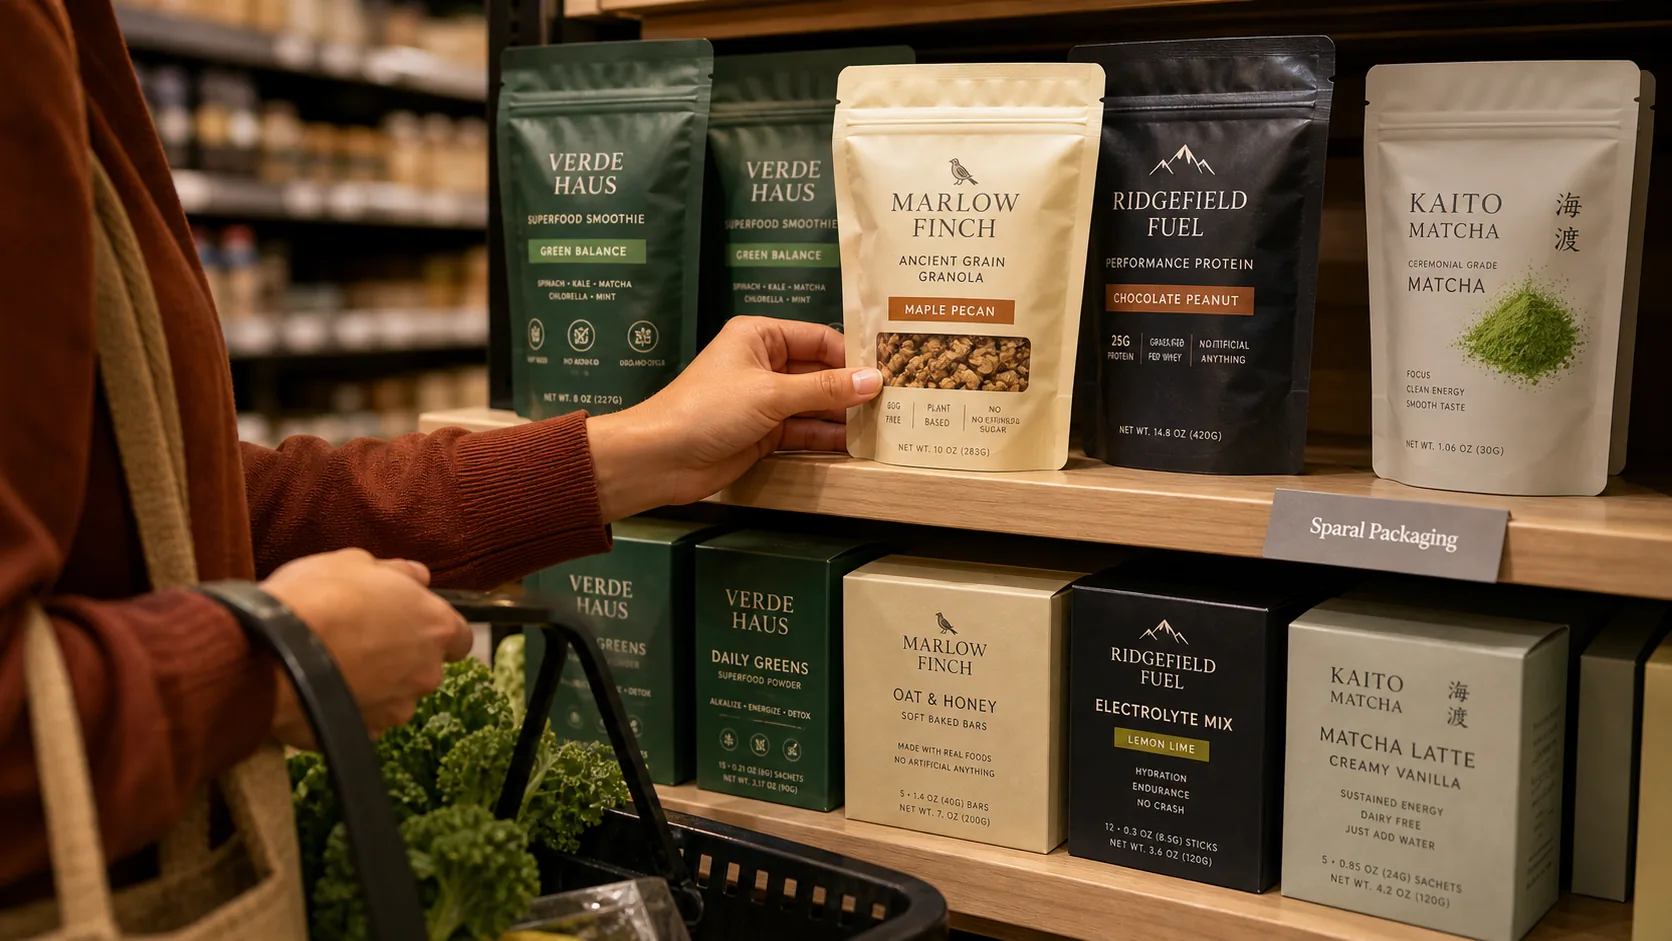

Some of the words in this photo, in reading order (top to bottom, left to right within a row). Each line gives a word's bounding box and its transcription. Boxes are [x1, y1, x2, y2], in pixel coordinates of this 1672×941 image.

[548, 152, 624, 172] VERDE
[746, 160, 822, 179] VERDE
[554, 175, 617, 195] HAUS
[751, 182, 815, 202] HAUS
[890, 192, 1020, 213] MARLOW
[1113, 190, 1248, 211] RIDGEFIELD
[1409, 192, 1503, 215] KAITO
[527, 213, 583, 225] SUPERFOOD
[586, 213, 645, 224] SMOOTHIE
[724, 218, 780, 230] SUPERFOOD
[782, 218, 837, 229] SMOOTHIE
[912, 218, 996, 238] FINCH
[1147, 217, 1204, 237] FUEL
[1554, 192, 1582, 252] 海渡
[1408, 222, 1500, 240] MATCHA
[540, 245, 572, 257] GREEN
[575, 245, 627, 257] BALANCE
[736, 249, 768, 261] GREEN
[771, 249, 821, 261] BALANCE
[898, 255, 958, 267] ANCIENT
[962, 255, 1005, 268] GRAIN
[1105, 257, 1190, 269] PERFORMANCE
[1195, 257, 1254, 270] PROTEIN
[1407, 259, 1464, 269] CEREMONIAL
[1466, 260, 1498, 270] GRADE
[537, 279, 566, 288] SPINACH
[572, 279, 591, 288] KALE
[598, 280, 633, 288] MATCHA
[918, 270, 984, 284] GRANOLA
[1408, 276, 1486, 294] MATCHA
[548, 292, 589, 301] CHLORELLA
[595, 292, 616, 301] MINT
[1113, 292, 1181, 305] CHOCOLATE
[1186, 293, 1239, 306] PEANUT
[904, 304, 946, 316] MAPLE
[951, 304, 995, 317] PECAN
[1111, 334, 1131, 347] 25G
[1107, 351, 1135, 361] PROTEIN
[1200, 354, 1246, 365] ANYTHING
[1406, 369, 1431, 380] FOCUS
[543, 392, 557, 402] NET
[558, 393, 572, 402] WT.
[580, 394, 592, 404] OZ
[593, 394, 623, 406] (227G)
[1406, 384, 1430, 394] CLEAN
[1431, 386, 1465, 397] ENERGY
[926, 403, 951, 413] PLANT
[988, 405, 1002, 414] NO
[1406, 399, 1438, 410] SMOOTH
[1440, 401, 1466, 412] TASTE
[924, 417, 950, 428] BASED
[1119, 425, 1134, 435] NET
[1135, 426, 1151, 436] WT.
[1153, 427, 1171, 437] 14.8
[1173, 428, 1187, 439] OZ
[1189, 429, 1222, 442] (420G)
[898, 443, 914, 452] NET
[915, 444, 931, 453] WT.
[933, 445, 944, 454] 10
[945, 446, 958, 455] OZ
[1405, 439, 1419, 449] NET
[1420, 441, 1435, 451] WT.
[1438, 442, 1457, 453] 1.06
[1459, 443, 1473, 454] OZ
[1475, 444, 1505, 457] (30G)
[1309, 516, 1366, 540] Sparal
[1368, 522, 1459, 553] Packaging
[569, 574, 633, 599] VERDE
[576, 596, 629, 620] HAUS
[725, 588, 794, 614] VERDE
[732, 611, 789, 635] HAUS
[596, 637, 646, 656] GREENS
[902, 635, 987, 657] MARLOW
[711, 649, 750, 667] DAILY
[754, 655, 809, 675] GREENS
[917, 655, 972, 676] FINCH
[1111, 646, 1216, 674] RIDGEFIELD
[717, 670, 765, 685] SUPERFOOD
[767, 677, 802, 690] POWDER
[1141, 669, 1185, 690] FUEL
[1331, 666, 1404, 693] KAITO
[709, 697, 742, 710] ALKALIZE
[748, 703, 782, 716] ENERGIZE
[787, 709, 812, 720] DETOX
[893, 687, 923, 704] OAT
[927, 692, 938, 706] &
[943, 694, 997, 714] HONEY
[1330, 690, 1403, 714] MATCHA
[1447, 680, 1470, 728] 海渡
[901, 711, 925, 722] SOFT
[928, 714, 960, 727] BAKED
[962, 719, 988, 731] BARS
[1095, 698, 1199, 727] ELECTROLYTE
[1204, 714, 1233, 732] MIX
[897, 742, 920, 753] MADE
[921, 745, 942, 756] WITH
[943, 748, 964, 759] REAL
[964, 751, 992, 763] FOODS
[1128, 734, 1165, 749] LEMON
[1169, 741, 1195, 754] LIME
[1320, 726, 1403, 756] MATCHA
[1411, 742, 1475, 769] LATTE
[894, 755, 907, 765] NO
[908, 758, 951, 772] ARTIFICIAL
[953, 765, 995, 778] ANYTHING
[1135, 766, 1187, 783] HYDRATION
[1329, 754, 1390, 776] CREAMY
[1395, 766, 1461, 790] VANILLA
[1132, 781, 1190, 800] ENDURANCE
[913, 792, 925, 800] 1.4
[926, 793, 939, 804] OZ
[940, 796, 965, 809] (40G)
[966, 800, 989, 812] BARS
[1136, 798, 1151, 808] NO
[1153, 801, 1185, 815] CRASH
[1340, 788, 1398, 808] SUSTAINED
[1401, 800, 1444, 817] ENERGY
[899, 803, 916, 813] NET
[918, 806, 935, 817] WT.
[946, 811, 959, 821] OZ
[961, 813, 991, 828] (200G)
[1360, 809, 1393, 824] DAIRY
[1395, 816, 1421, 831] FREE
[1106, 822, 1113, 833] 12
[1123, 825, 1138, 837] 0.3
[1139, 829, 1153, 840] OZ
[1155, 832, 1183, 847] (8.5G)
[1185, 838, 1218, 853] STICKS
[1345, 824, 1370, 837] JUST
[1372, 830, 1396, 842] ADD
[1398, 835, 1436, 851] WATER
[1109, 838, 1127, 849] NET
[1129, 842, 1146, 854] WT.
[1148, 845, 1163, 857] 3.6
[1165, 849, 1179, 860] OZ
[1181, 852, 1213, 868] (120G)
[1322, 854, 1327, 865] 5
[1339, 858, 1361, 872] 0.85
[1364, 864, 1379, 876] OZ
[1382, 868, 1411, 884] (24G)
[1414, 875, 1463, 894] SACHETS
[1330, 873, 1350, 886] NET
[1353, 878, 1374, 892] WT.
[1376, 883, 1393, 896] 4.2
[1395, 887, 1412, 900] OZ
[1415, 891, 1451, 910] (120G)
